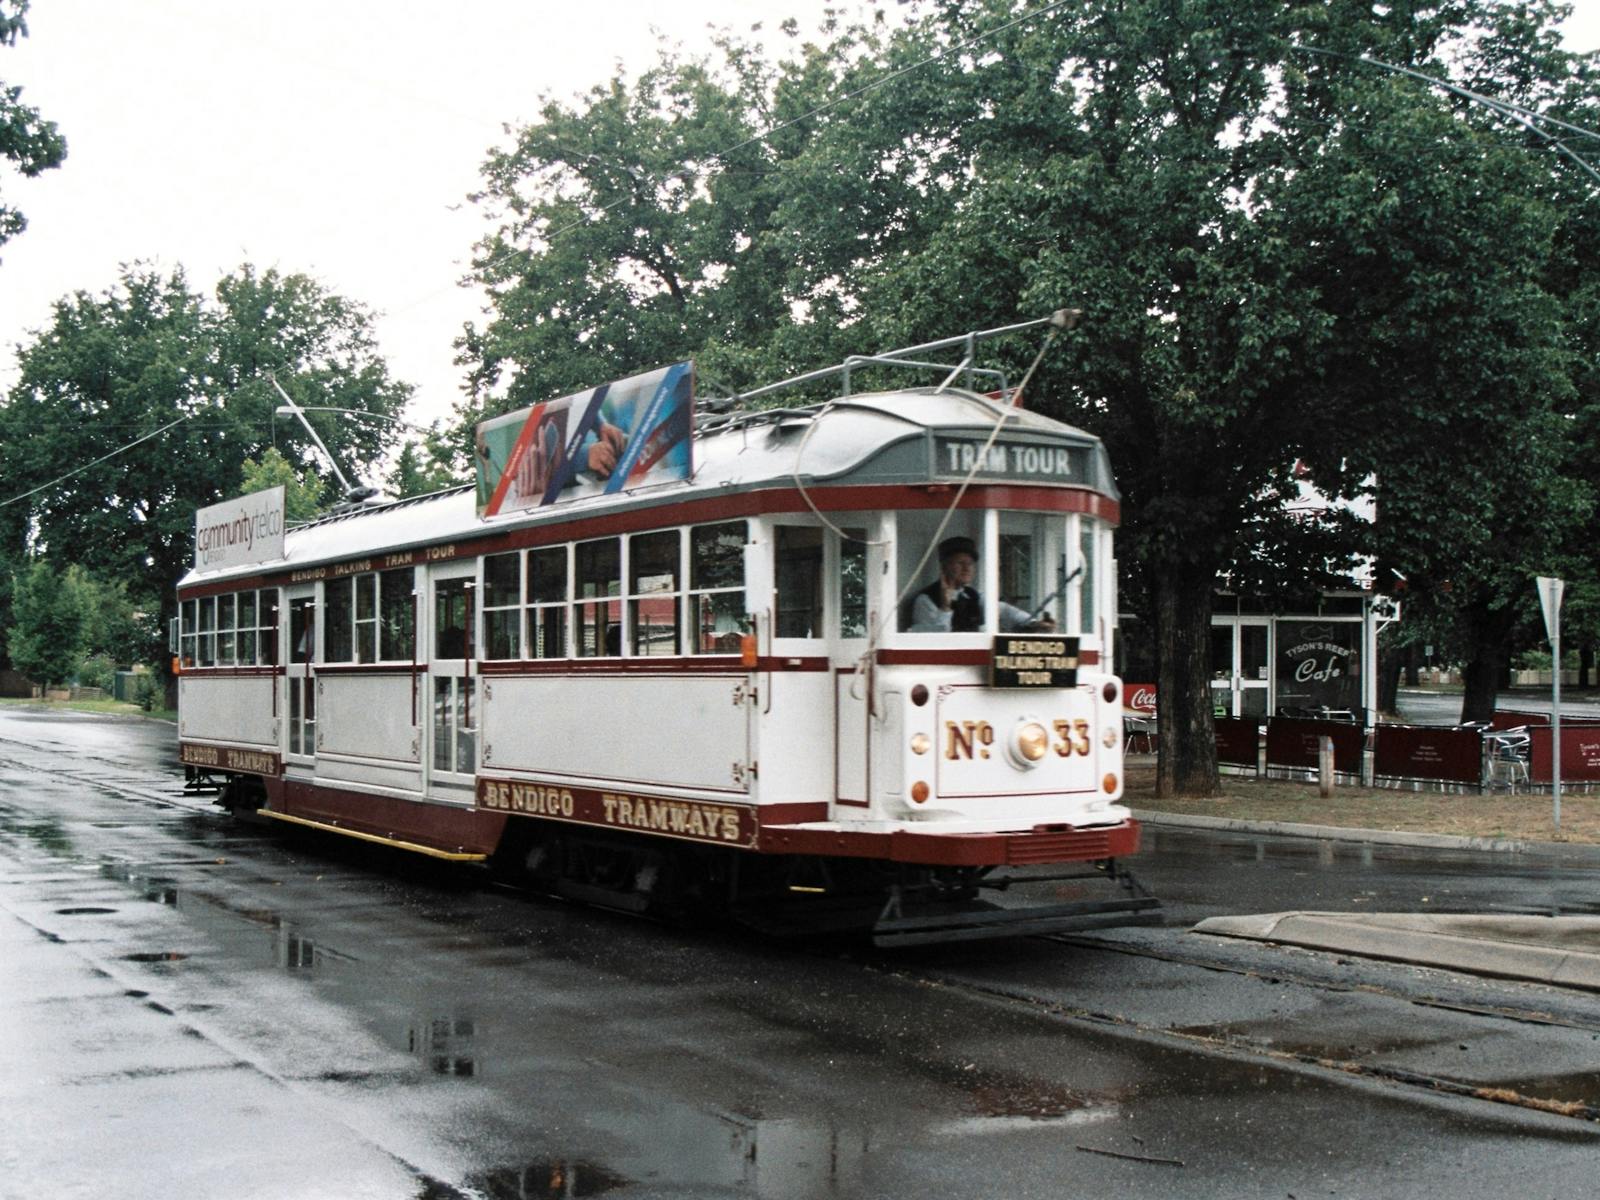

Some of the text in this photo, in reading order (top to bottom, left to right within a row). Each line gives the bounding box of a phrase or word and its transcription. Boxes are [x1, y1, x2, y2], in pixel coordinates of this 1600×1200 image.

[945, 442, 1071, 475] TRAM TOUR
[290, 545, 455, 582] BENDIGO TALKING TRAM TOUR
[1007, 641, 1066, 655] BENDIGO
[1285, 641, 1324, 657] TYSON'S
[995, 655, 1045, 669] TALKING
[1295, 655, 1341, 682] Cafe
[1017, 671, 1052, 685] TOUR
[1053, 718, 1091, 758] 33
[484, 781, 740, 841] BENDIGO TRAMWAYS
